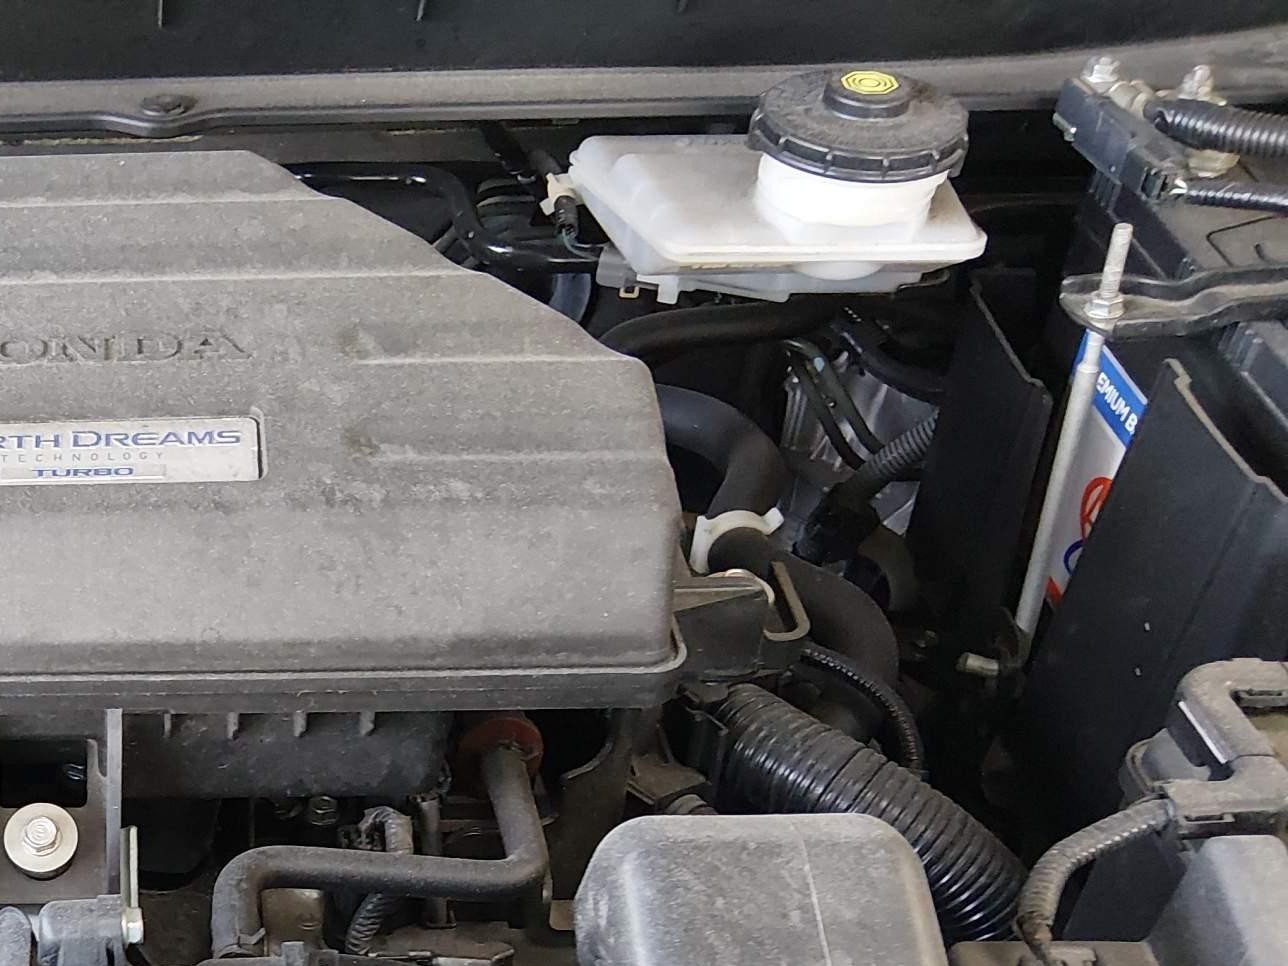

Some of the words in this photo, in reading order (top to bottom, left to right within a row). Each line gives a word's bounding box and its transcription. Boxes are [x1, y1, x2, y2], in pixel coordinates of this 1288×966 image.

[1096, 371, 1131, 422] EMIUM
[0, 452, 165, 464] TECHNOLOGY
[32, 467, 134, 477] TURBO
